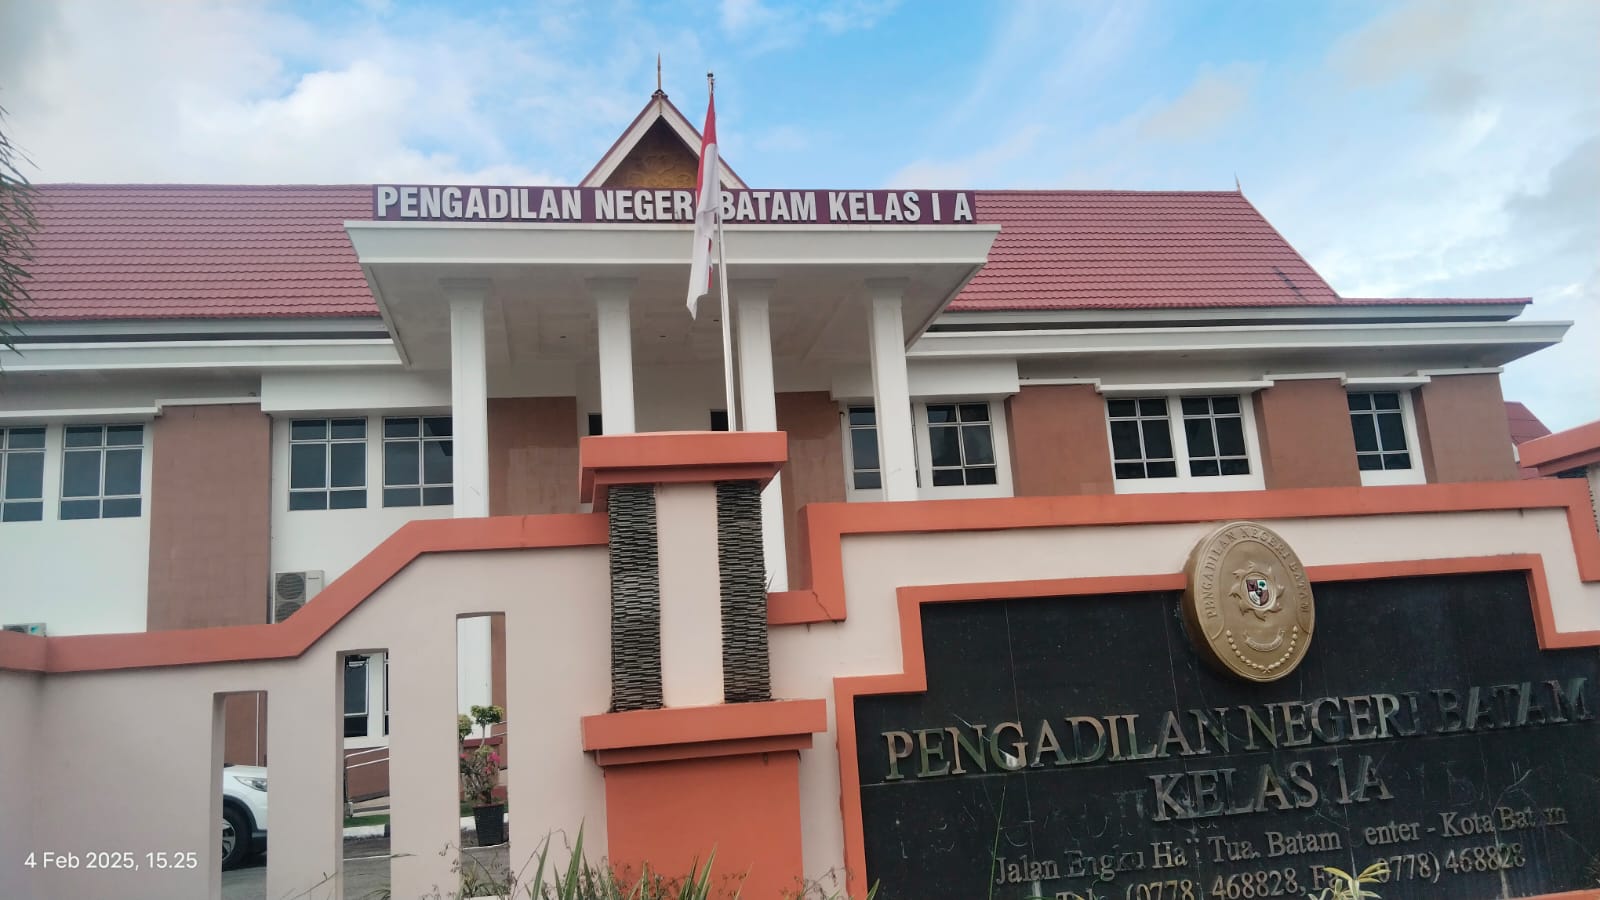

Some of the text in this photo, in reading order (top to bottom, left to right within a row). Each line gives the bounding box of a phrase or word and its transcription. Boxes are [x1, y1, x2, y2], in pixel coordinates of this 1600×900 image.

[376, 185, 973, 222] PENGADILAN NEGER BATAM KELAS I A
[1201, 530, 1237, 620] PENGADILAN
[881, 677, 1596, 781] PENGADILAN NEGERI BATAM
[1147, 761, 1321, 823] KELAS
[1334, 754, 1395, 806] 1A
[995, 854, 1059, 886] Jalan
[1150, 837, 1203, 869] Hai
[1265, 828, 1342, 858] Batam
[1349, 820, 1420, 848] enter
[1440, 810, 1495, 838] Kota
[1497, 806, 1569, 832] Batm
[1446, 842, 1526, 874] 468828
